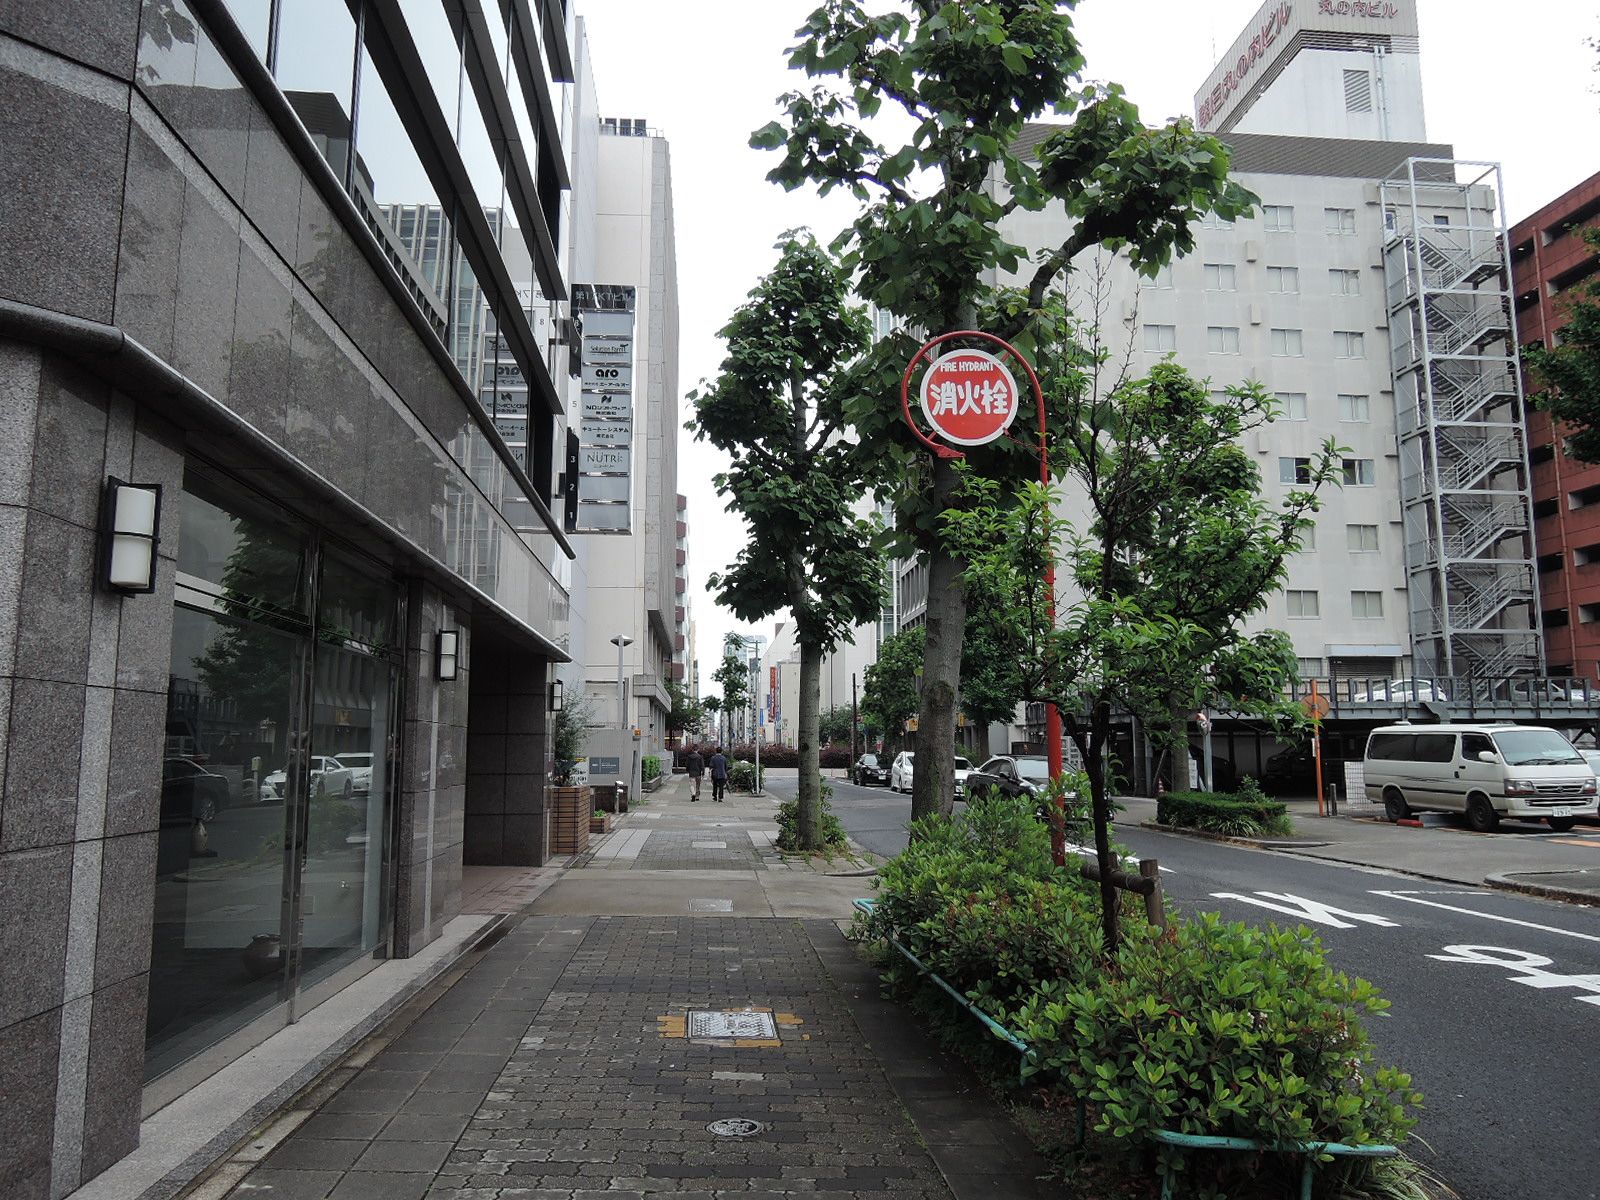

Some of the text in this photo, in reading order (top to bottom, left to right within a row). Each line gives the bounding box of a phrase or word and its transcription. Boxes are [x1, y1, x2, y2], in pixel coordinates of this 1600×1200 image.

[941, 361, 994, 372] FIRE HYDRANT
[595, 369, 619, 378] aro
[930, 379, 1009, 416] 消火栓
[570, 455, 576, 463] 3
[569, 483, 575, 491] 2
